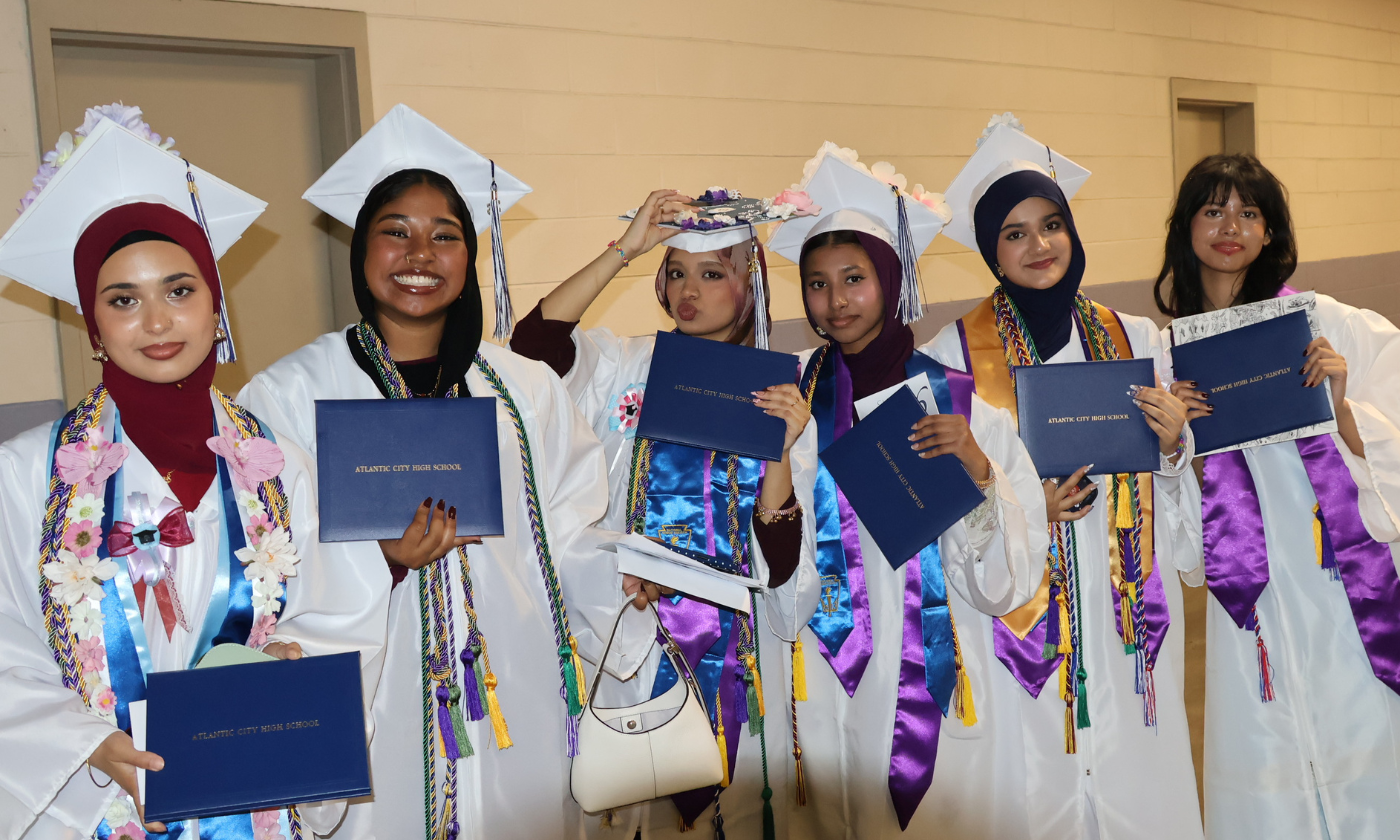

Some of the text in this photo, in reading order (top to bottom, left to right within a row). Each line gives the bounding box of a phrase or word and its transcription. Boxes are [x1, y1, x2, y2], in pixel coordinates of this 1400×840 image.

[1210, 367, 1292, 393] ATLANTIC CITY HIGH SCHOOL
[674, 384, 753, 403] ATLANTIC CITY HIGH SCHO
[1048, 416, 1075, 424] ATLANTIC
[355, 465, 391, 473] ATLANTIC
[392, 464, 410, 472] CITY
[433, 463, 462, 471] SCHOOL
[876, 440, 925, 509] ATLANTIC CITY HIGH SCHOOL
[192, 719, 320, 740] ATLANTIC CITY HIGH SCHOOL
